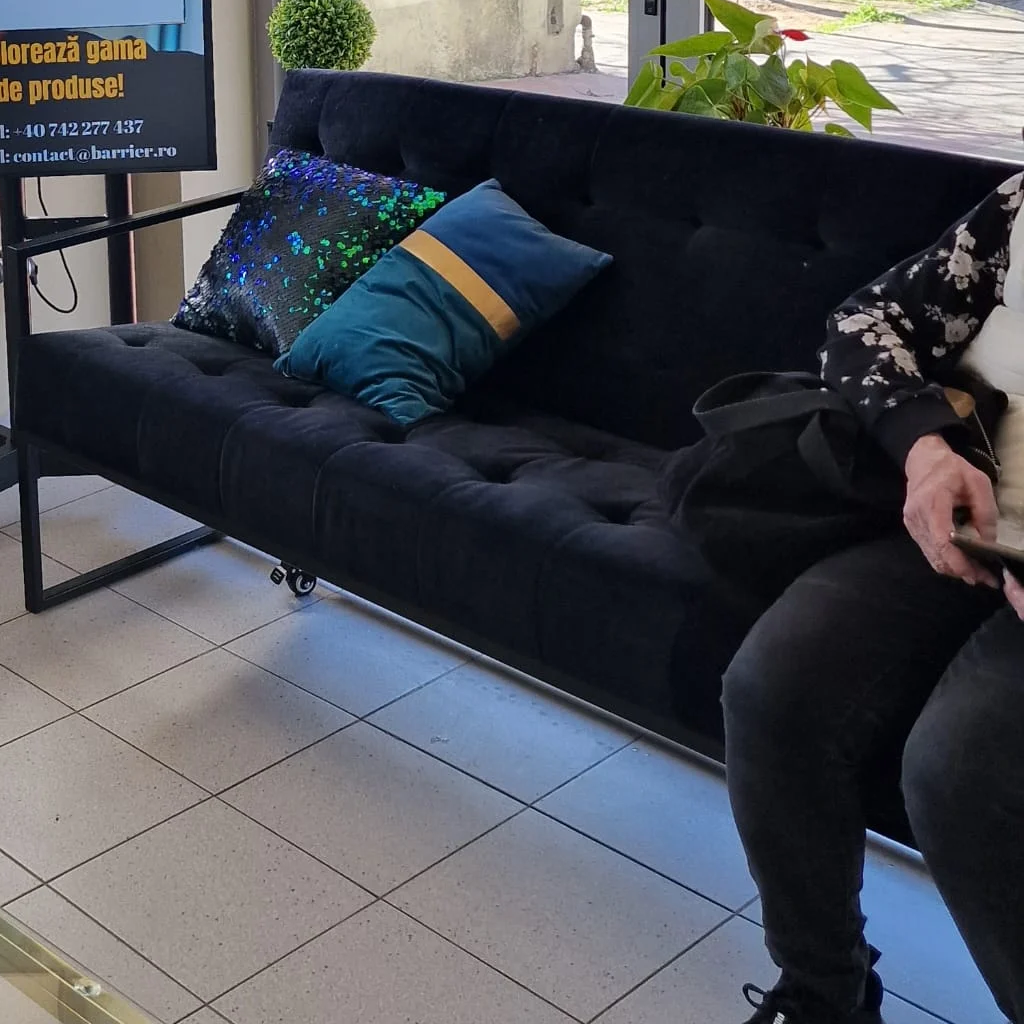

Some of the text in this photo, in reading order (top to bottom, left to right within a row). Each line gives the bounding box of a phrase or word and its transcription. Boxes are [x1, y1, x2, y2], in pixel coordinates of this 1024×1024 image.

[87, 38, 147, 64] gama
[29, 73, 125, 105] produse!
[13, 124, 46, 137] +40
[48, 122, 78, 136] 742
[81, 121, 110, 135] 277
[113, 120, 144, 134] 437
[13, 144, 177, 163] contact@barrier.ro
